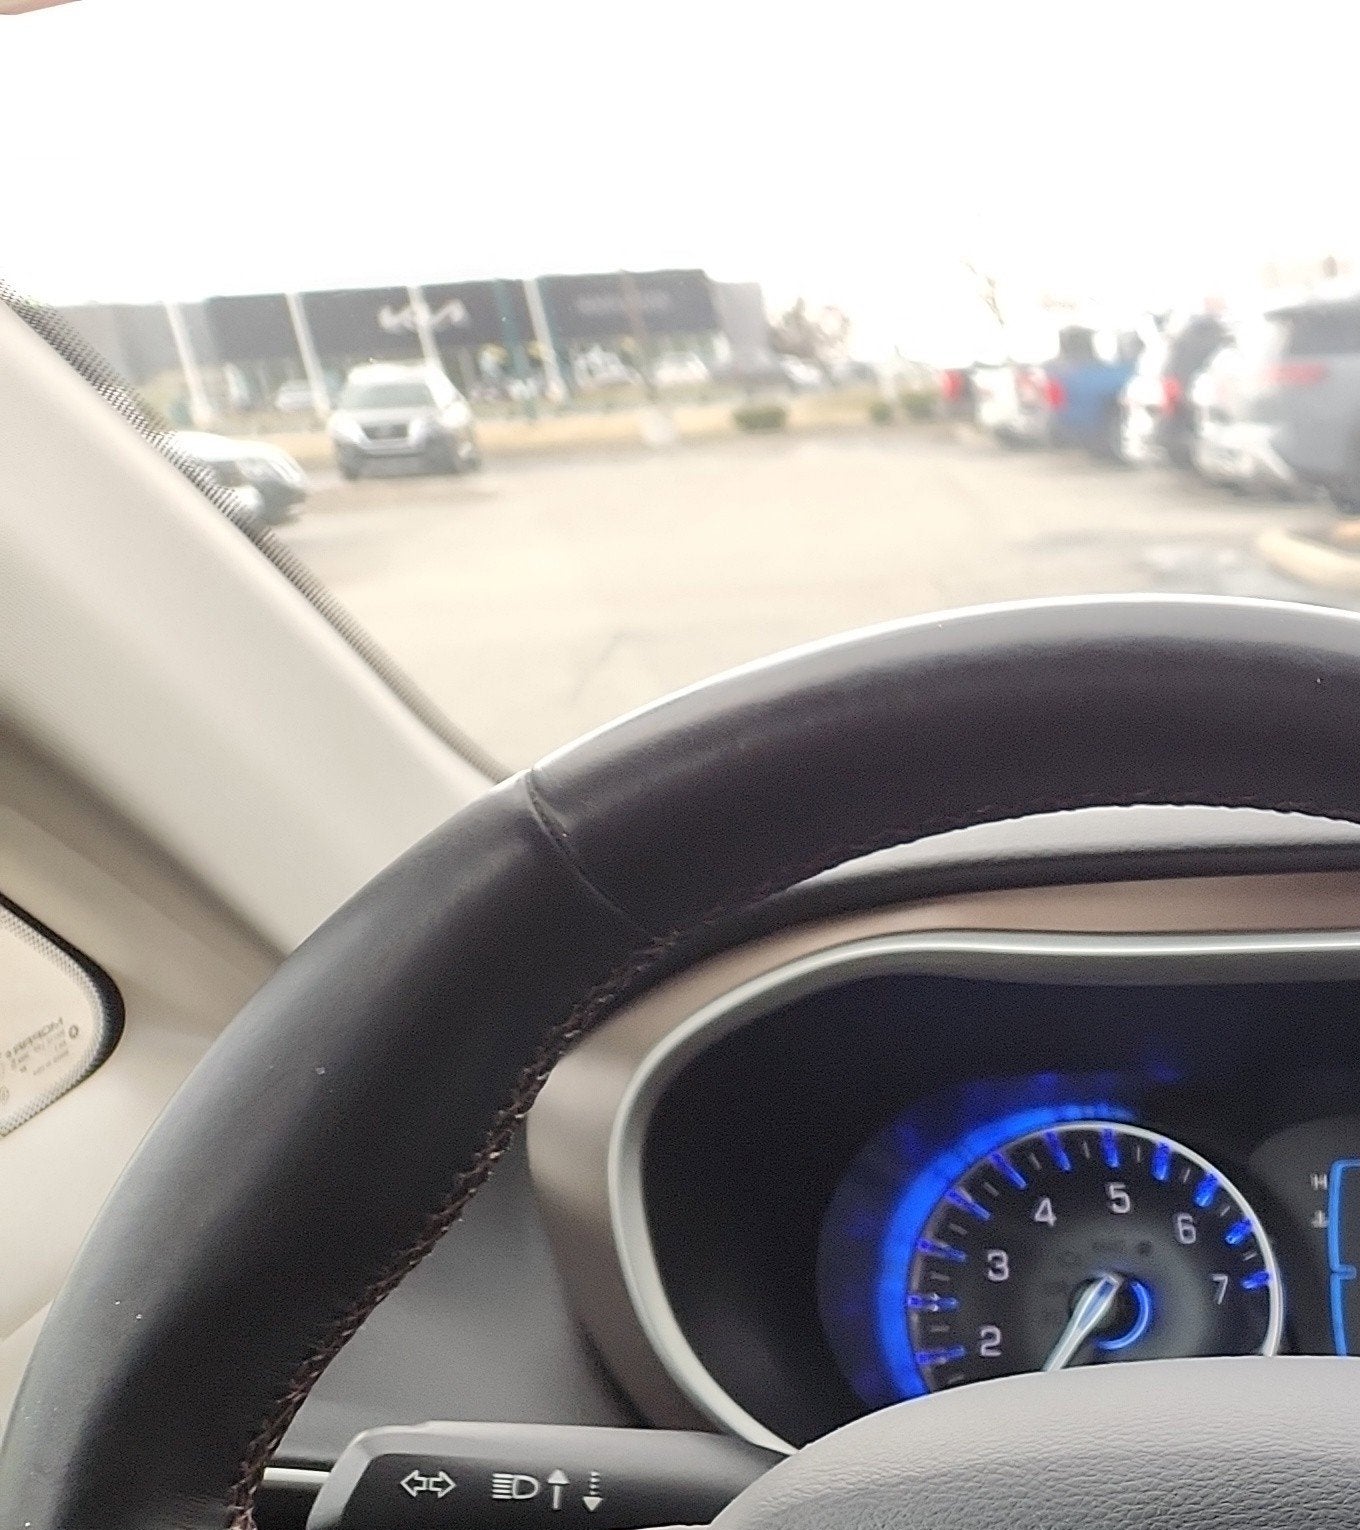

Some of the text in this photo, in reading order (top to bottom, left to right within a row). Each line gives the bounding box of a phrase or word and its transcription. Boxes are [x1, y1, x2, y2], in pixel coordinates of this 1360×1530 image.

[1034, 1197, 1057, 1227] 4
[1108, 1183, 1131, 1214] 5
[1176, 1212, 1197, 1245] 6
[987, 1249, 1010, 1282] 3
[1212, 1273, 1230, 1305] 7
[979, 1325, 1002, 1358] 2
